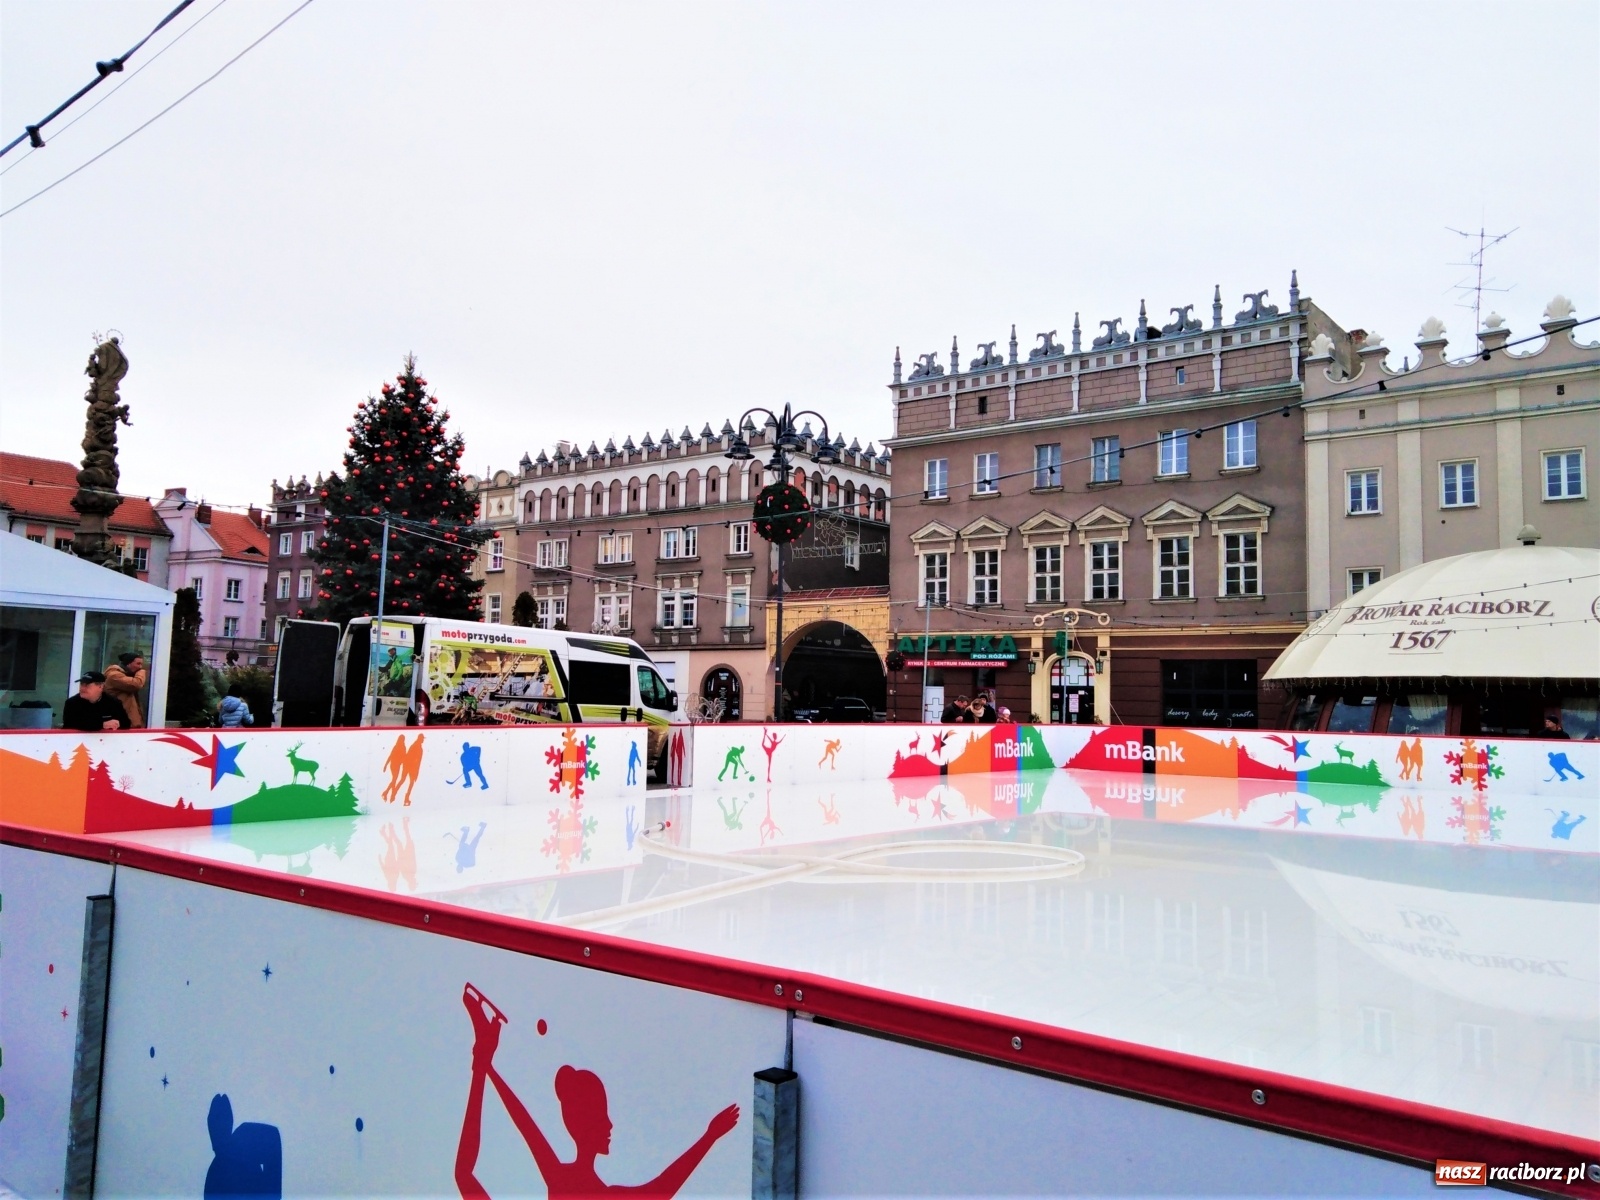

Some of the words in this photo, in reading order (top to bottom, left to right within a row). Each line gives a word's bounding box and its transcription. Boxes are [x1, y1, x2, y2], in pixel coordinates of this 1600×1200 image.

[1343, 602, 1424, 624] BROWAR
[1427, 598, 1554, 617] RACIBÓRZ
[442, 630, 527, 644] motoprzygoda.com
[898, 634, 1017, 653] APTEKA
[1389, 629, 1453, 650] 1567
[994, 737, 1034, 758] mBank
[1104, 741, 1185, 762] mBank
[560, 761, 585, 769] mBank
